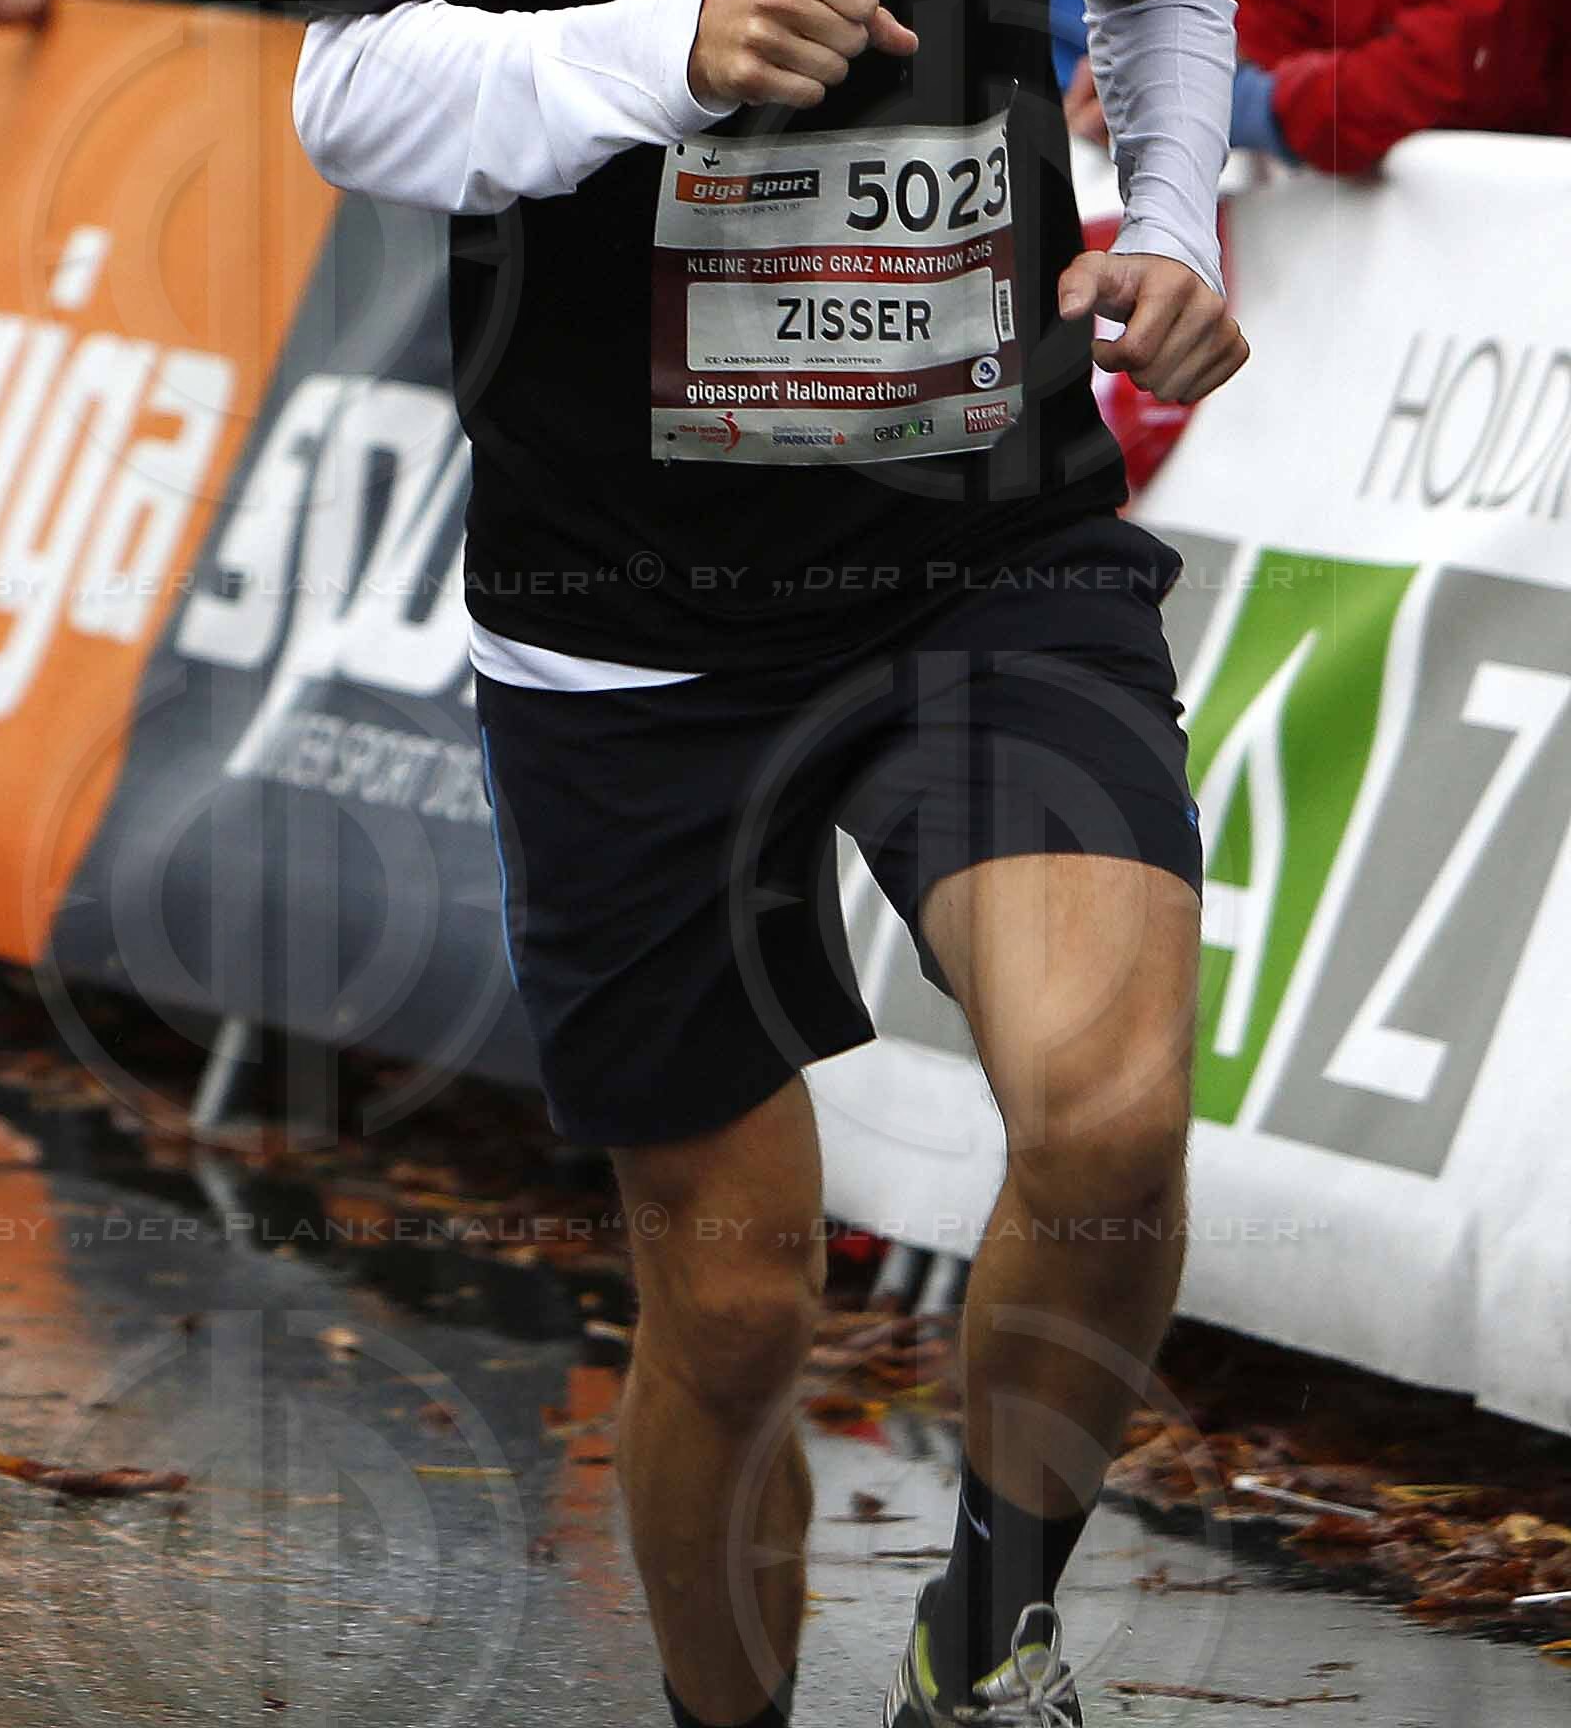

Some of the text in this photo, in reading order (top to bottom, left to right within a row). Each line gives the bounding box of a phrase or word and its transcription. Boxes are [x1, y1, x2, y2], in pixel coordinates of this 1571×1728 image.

[692, 176, 814, 201] giga sport
[845, 146, 1008, 233] 5023
[687, 240, 993, 275] KLEINE ZEITUNG GRAZ MARATHON 2015
[776, 297, 933, 342] ZISSER
[686, 379, 918, 406] gigasport Halbmarathon
